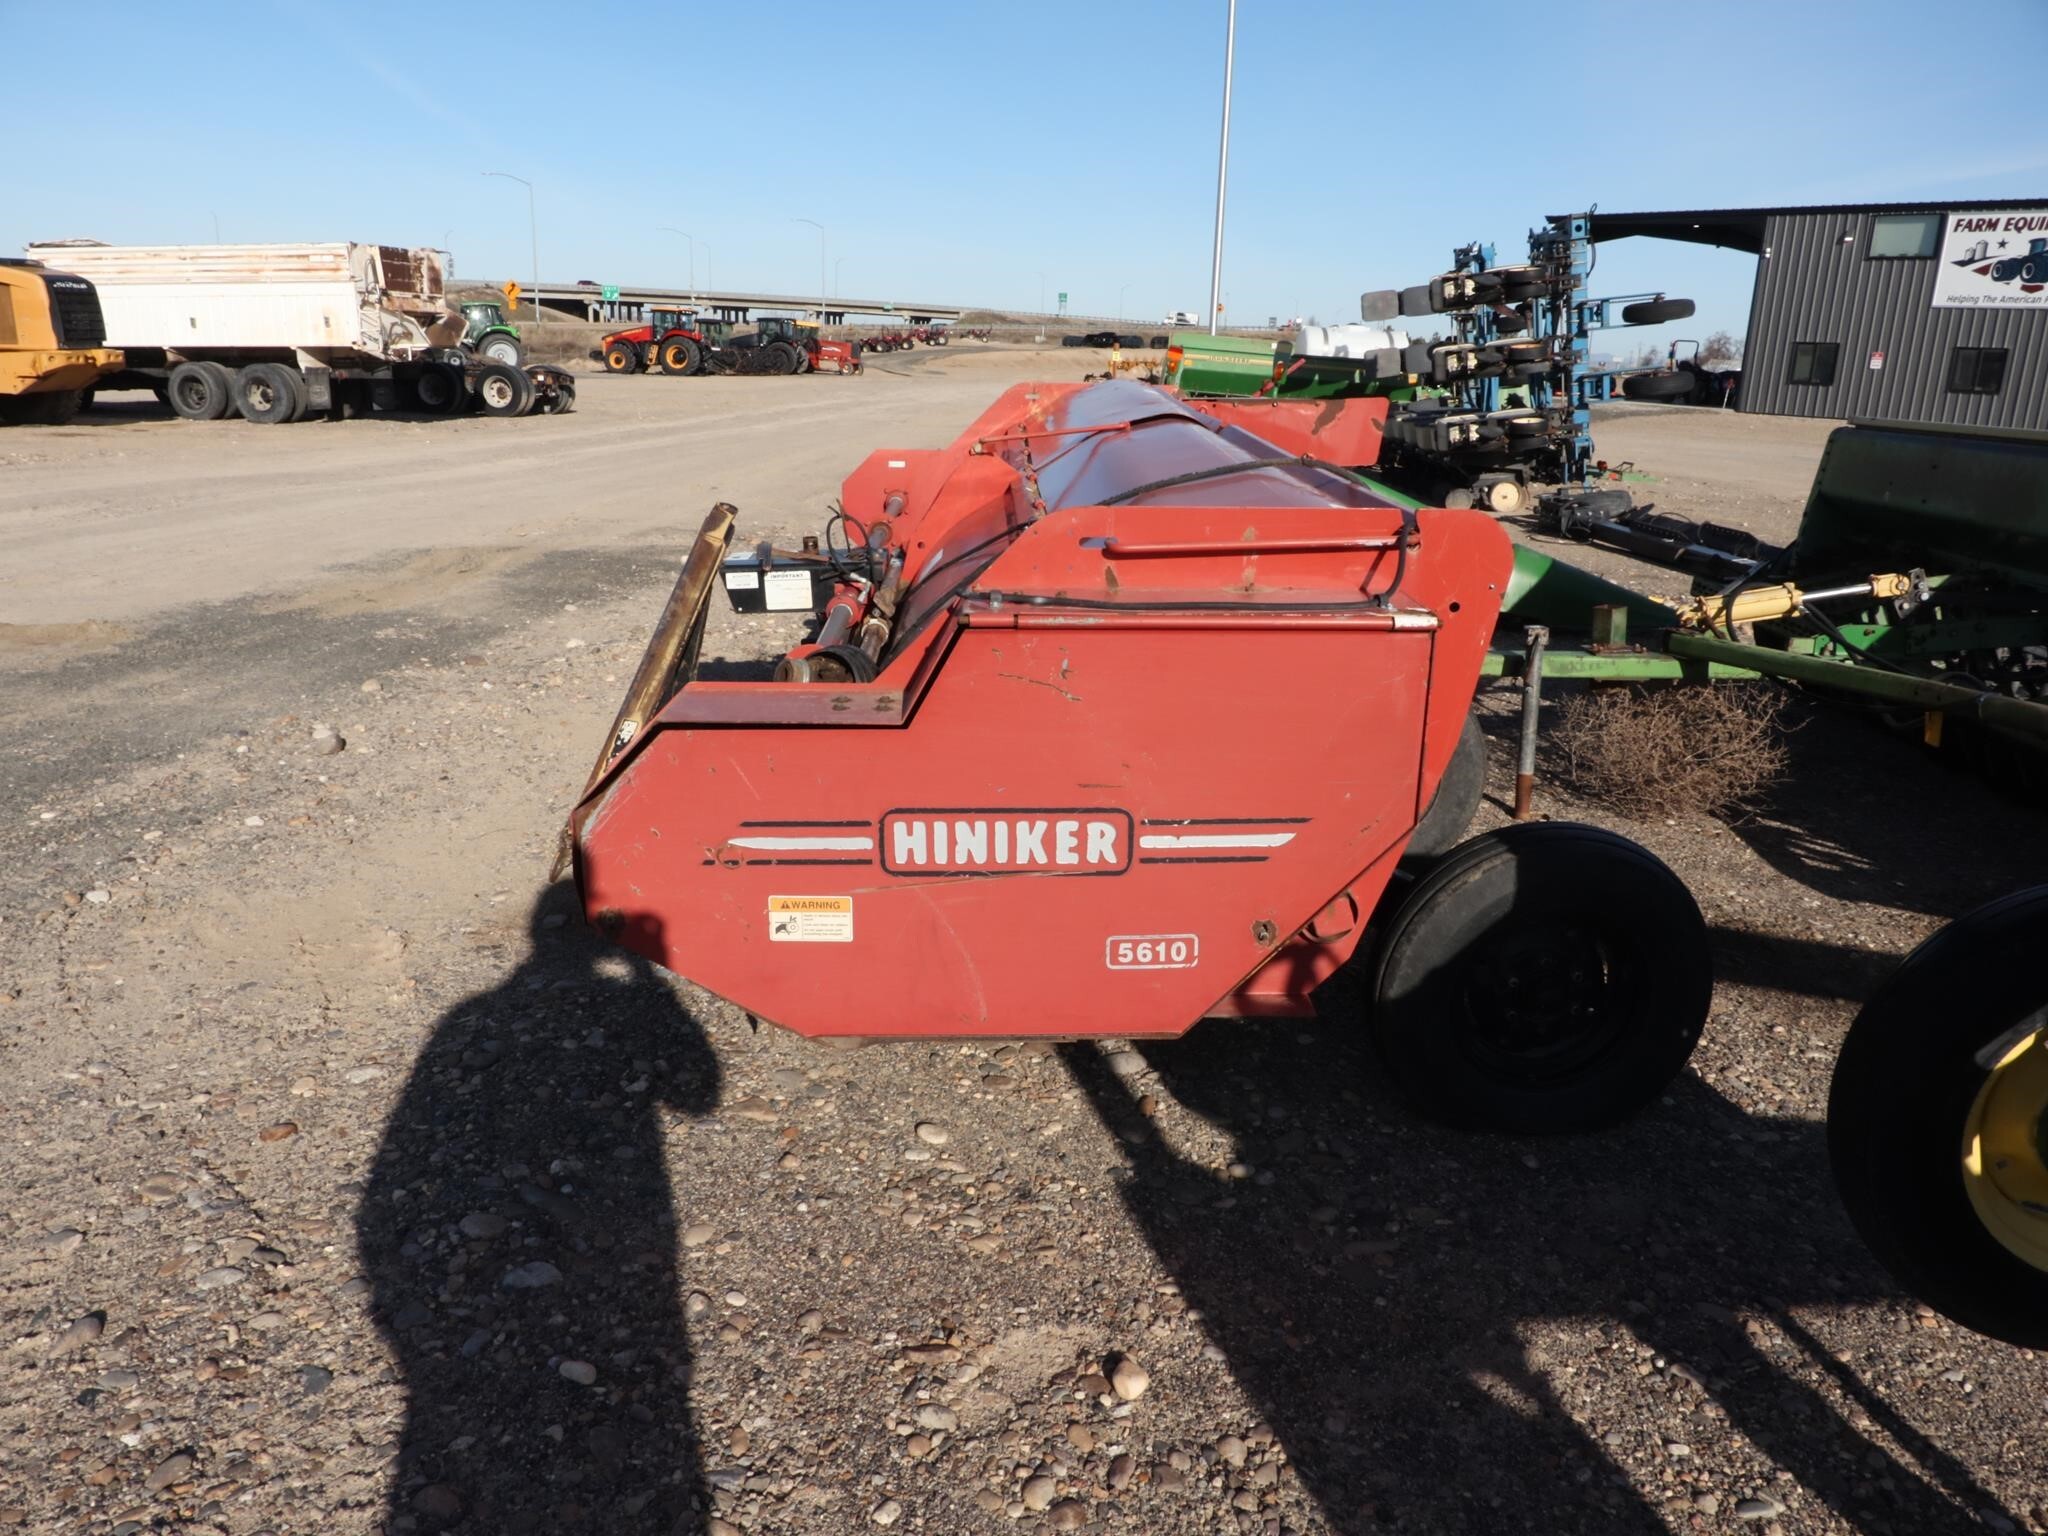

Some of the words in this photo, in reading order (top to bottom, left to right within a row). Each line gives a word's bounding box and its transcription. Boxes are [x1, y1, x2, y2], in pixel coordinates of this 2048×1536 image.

[1953, 217, 2001, 232] FARM
[2003, 216, 2048, 233] EQUI
[1946, 295, 1980, 304] Helping
[1982, 294, 1997, 304] The
[1999, 294, 2042, 304] American
[892, 819, 1118, 865] HINIKER
[791, 900, 841, 910] WARNING
[1117, 940, 1187, 964] 5610
